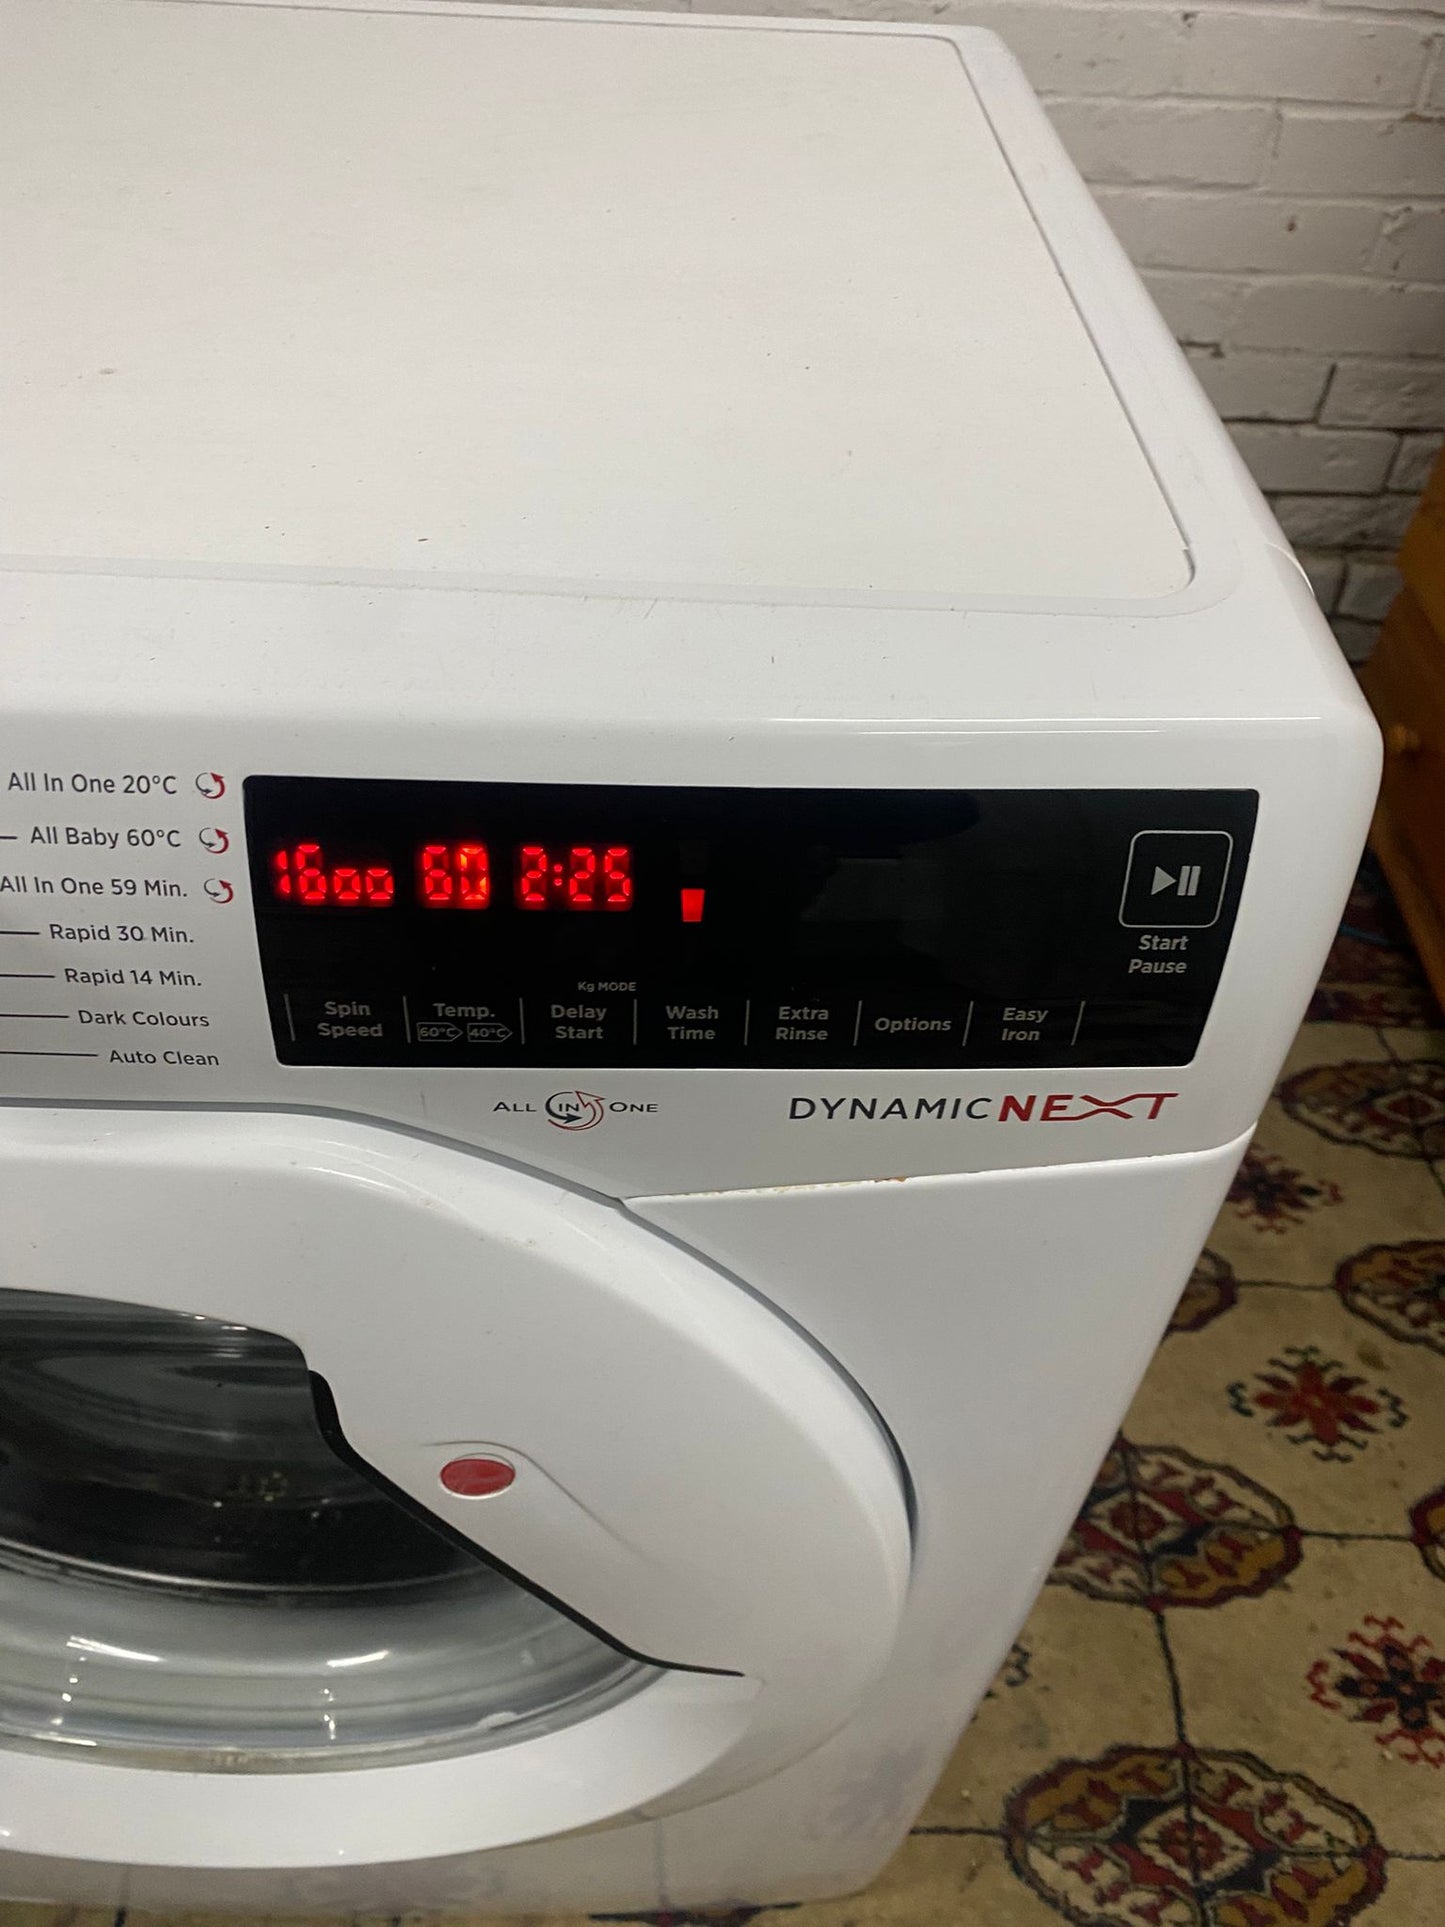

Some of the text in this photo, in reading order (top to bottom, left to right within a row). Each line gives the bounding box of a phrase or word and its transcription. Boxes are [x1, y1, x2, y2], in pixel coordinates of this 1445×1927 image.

[8, 772, 177, 795] All In One 20°C
[30, 827, 181, 849] All Baby 60°C
[521, 847, 632, 902] 2:25
[0, 876, 188, 898] All In One 59 Min.
[49, 924, 195, 944] Rapid 30 Min.
[1138, 934, 1189, 951] Start
[1127, 958, 1188, 974] Pause
[64, 968, 203, 987] Rapid 14 Min.
[577, 981, 637, 993] Kg MODE
[324, 1001, 371, 1018] Spin
[433, 1003, 496, 1020] Temp.
[551, 1004, 607, 1021] Delay
[665, 1005, 719, 1020] Wash
[778, 1006, 829, 1021] Extra
[1002, 1007, 1048, 1023] Easy
[78, 1010, 210, 1028] Dark Colours
[874, 1017, 952, 1034] Options
[317, 1022, 384, 1039] Speed
[555, 1025, 604, 1040] Start
[667, 1026, 716, 1040] Time
[775, 1027, 829, 1041] Rinse
[1001, 1028, 1040, 1041] Iron
[109, 1050, 220, 1067] Auto Clean
[493, 1101, 537, 1113] ALL
[609, 1101, 659, 1113] ONE
